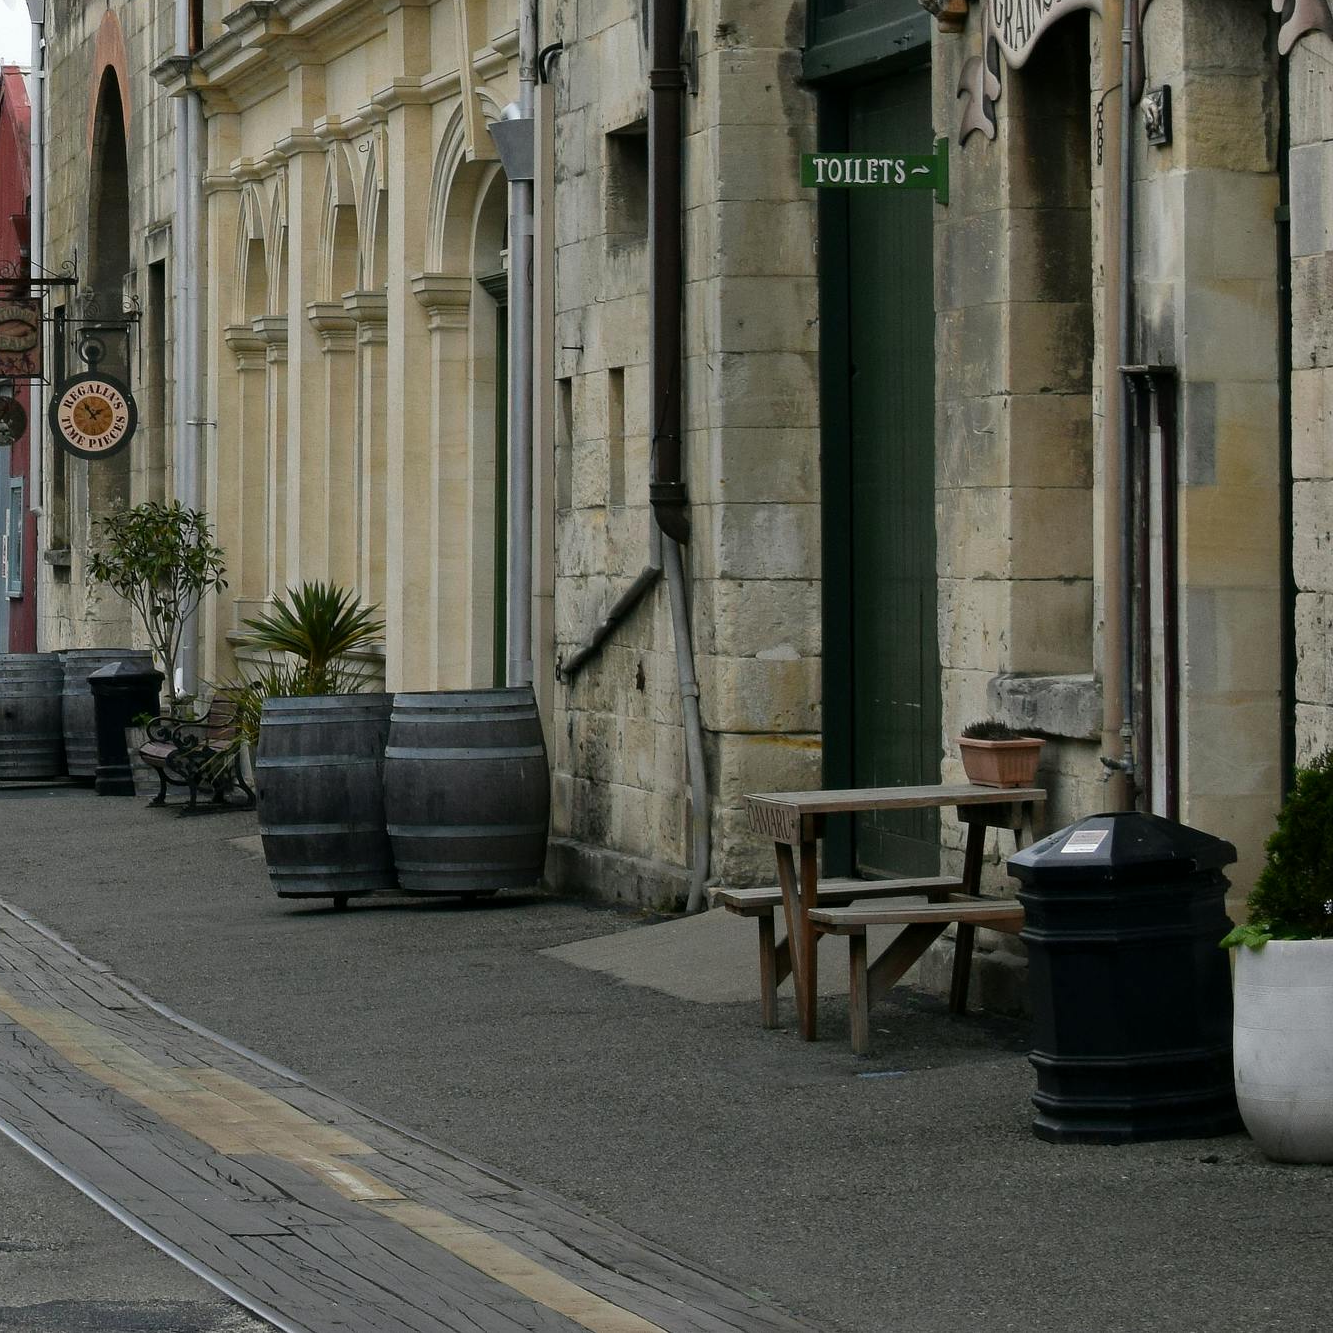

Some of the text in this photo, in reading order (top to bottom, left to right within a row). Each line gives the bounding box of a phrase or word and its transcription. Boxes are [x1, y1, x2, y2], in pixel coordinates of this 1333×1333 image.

[812, 157, 906, 184] TOILETS
[63, 384, 124, 410] REGALIA'S
[61, 415, 126, 448] TIME PIECES
